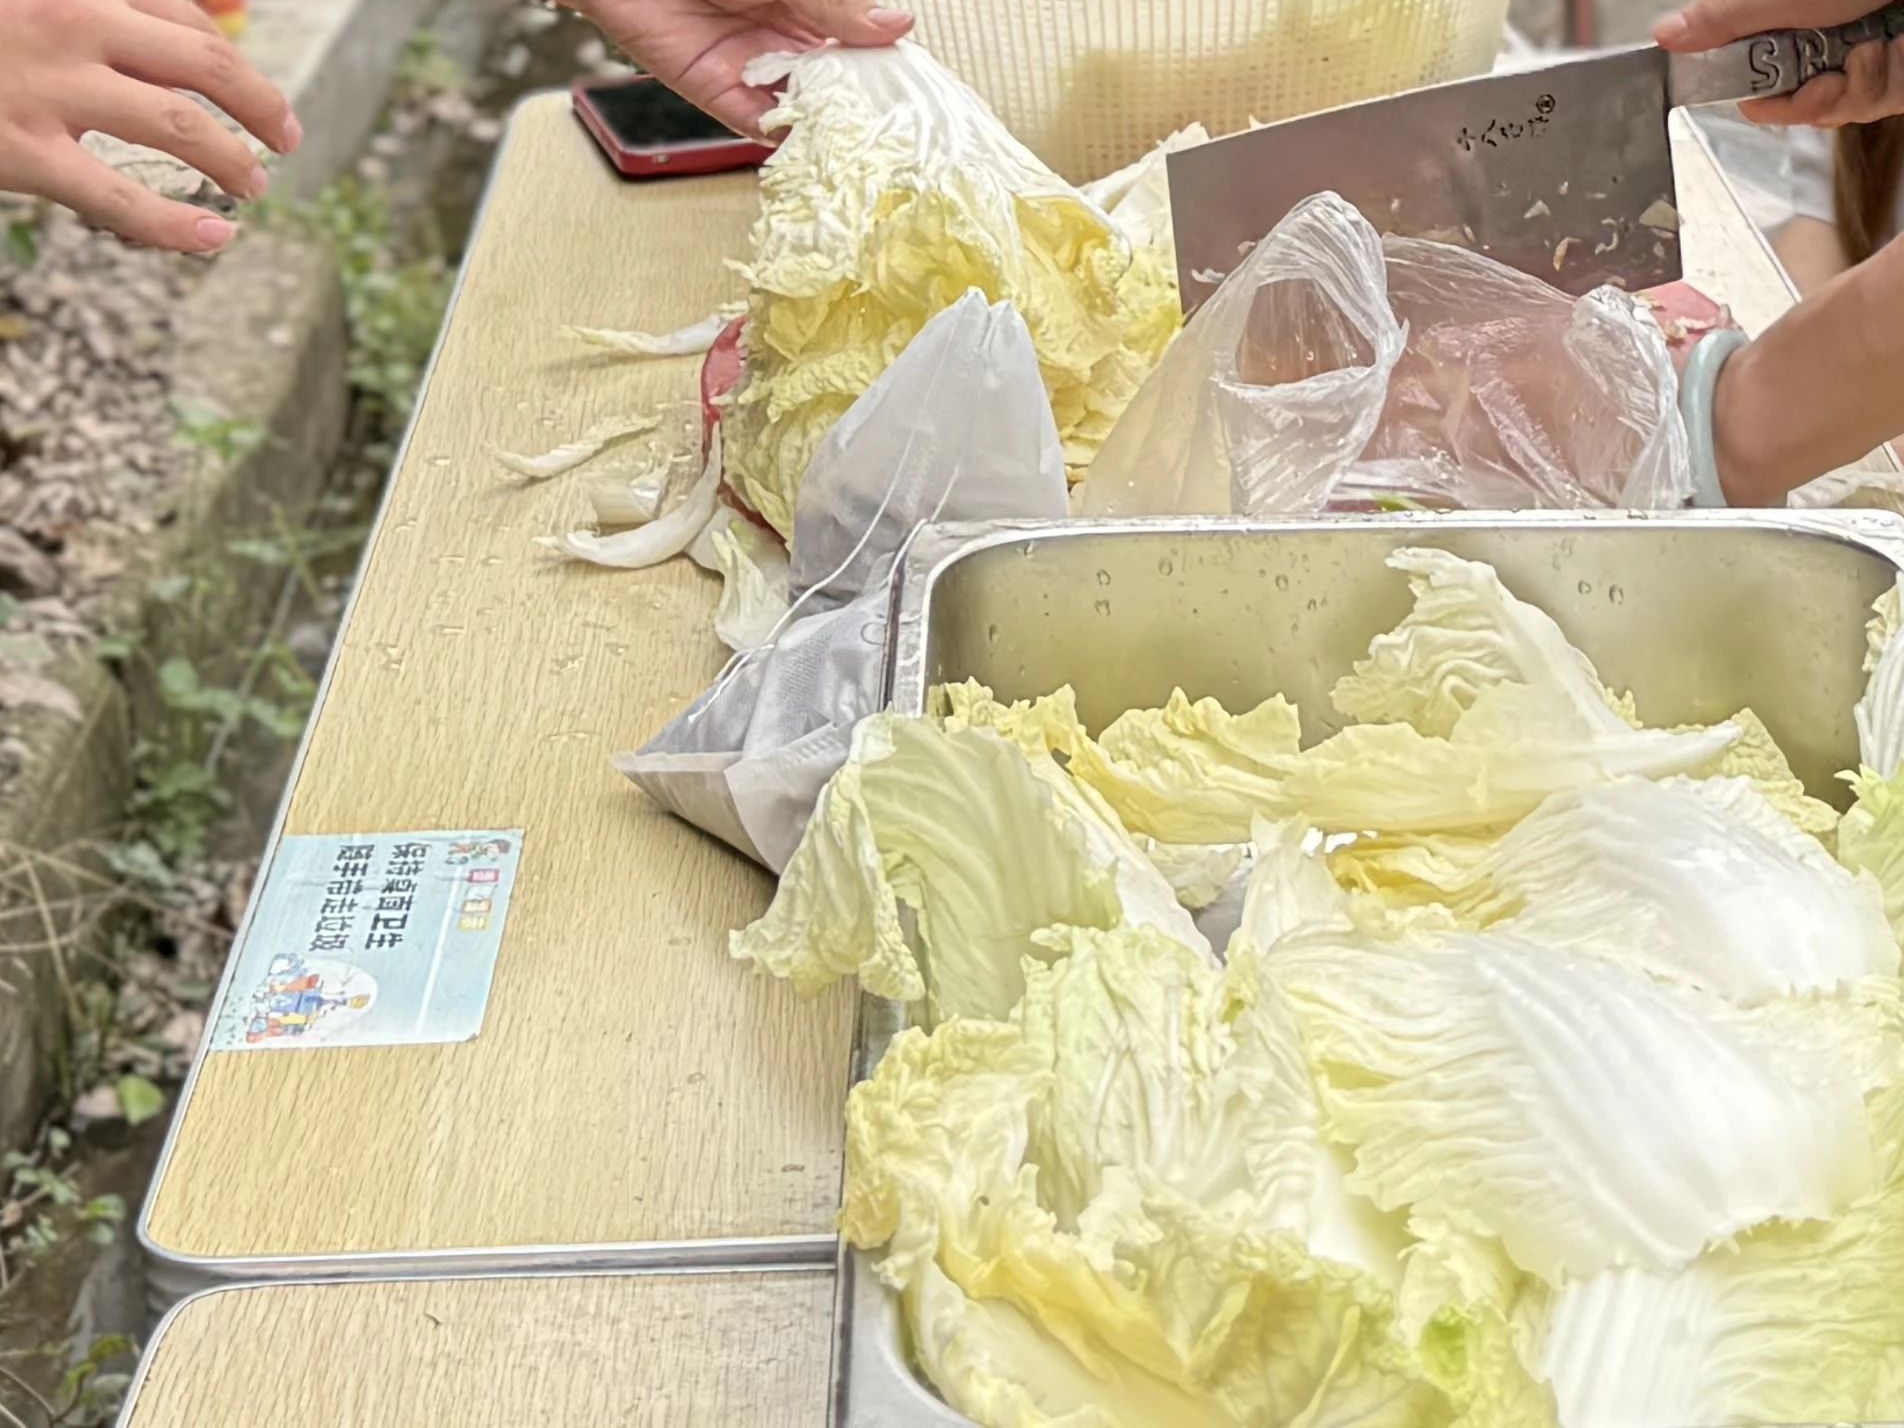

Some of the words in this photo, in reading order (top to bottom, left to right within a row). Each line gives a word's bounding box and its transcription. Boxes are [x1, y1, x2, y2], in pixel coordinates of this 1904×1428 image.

[309, 842, 375, 952] 随手带走垃圾
[364, 842, 431, 951] 保持桌面卫生
